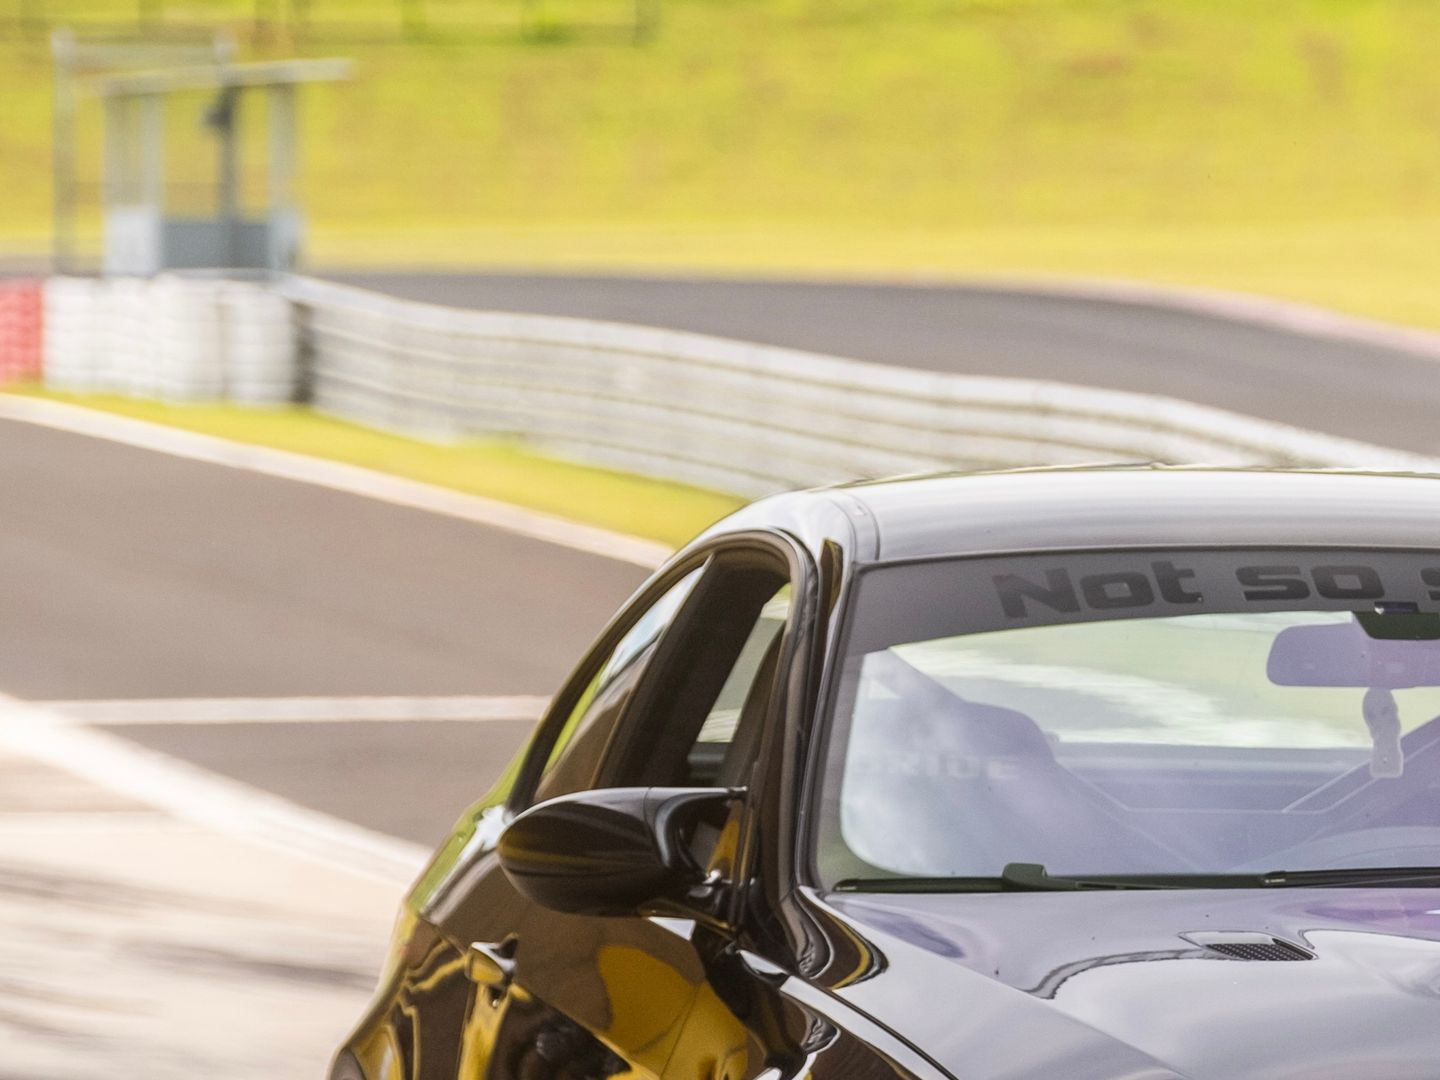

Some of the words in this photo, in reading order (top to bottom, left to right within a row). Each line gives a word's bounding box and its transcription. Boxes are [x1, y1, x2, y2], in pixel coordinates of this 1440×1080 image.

[992, 560, 1203, 619] Not
[1236, 564, 1386, 602] so
[851, 751, 1020, 780] RIDE
